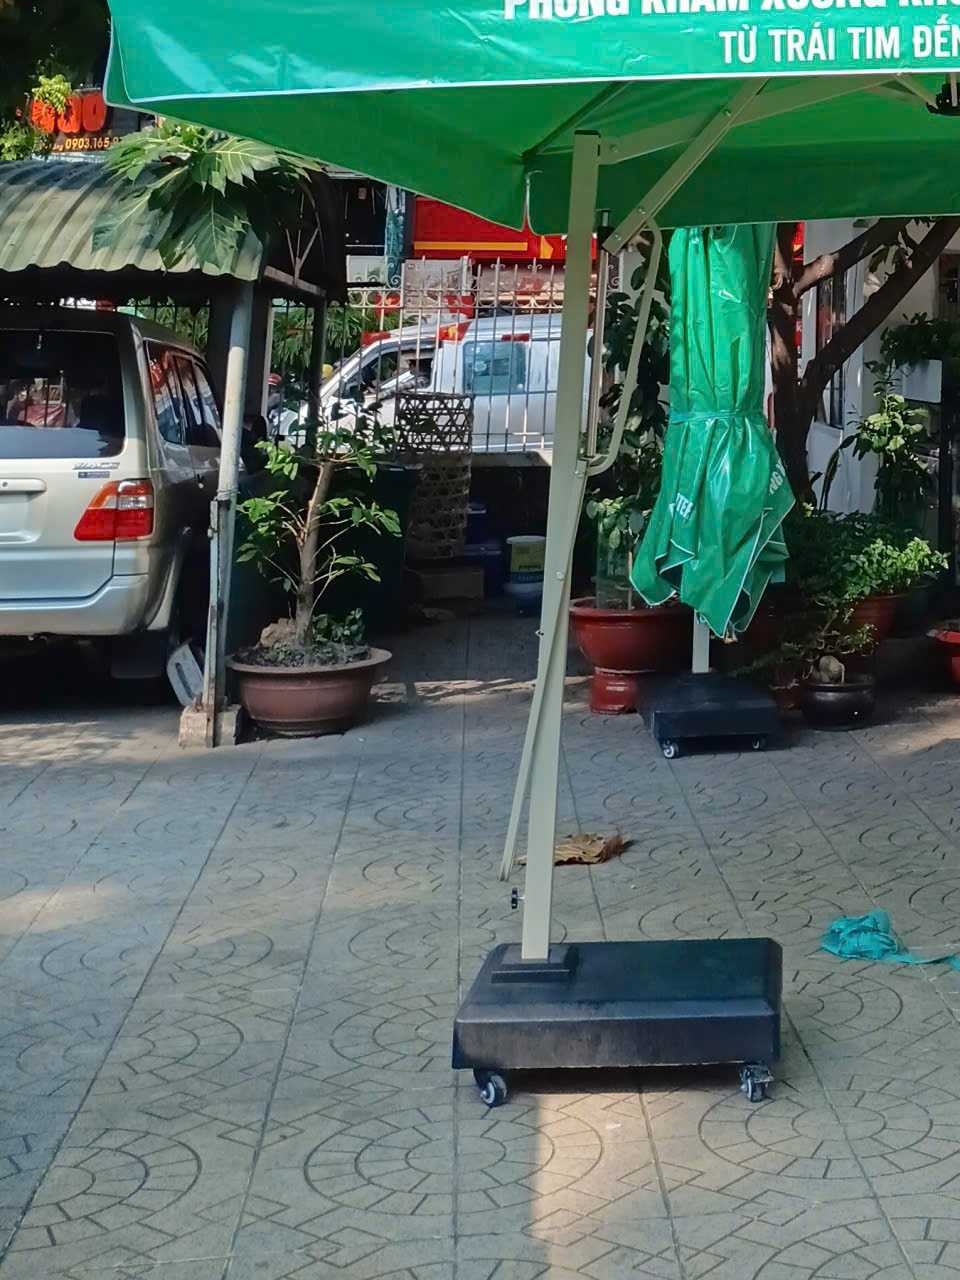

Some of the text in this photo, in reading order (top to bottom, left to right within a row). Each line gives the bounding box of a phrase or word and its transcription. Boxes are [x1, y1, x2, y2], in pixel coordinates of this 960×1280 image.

[718, 24, 758, 64] TỪ
[768, 22, 836, 63] TRÁI
[847, 26, 901, 61] TIM
